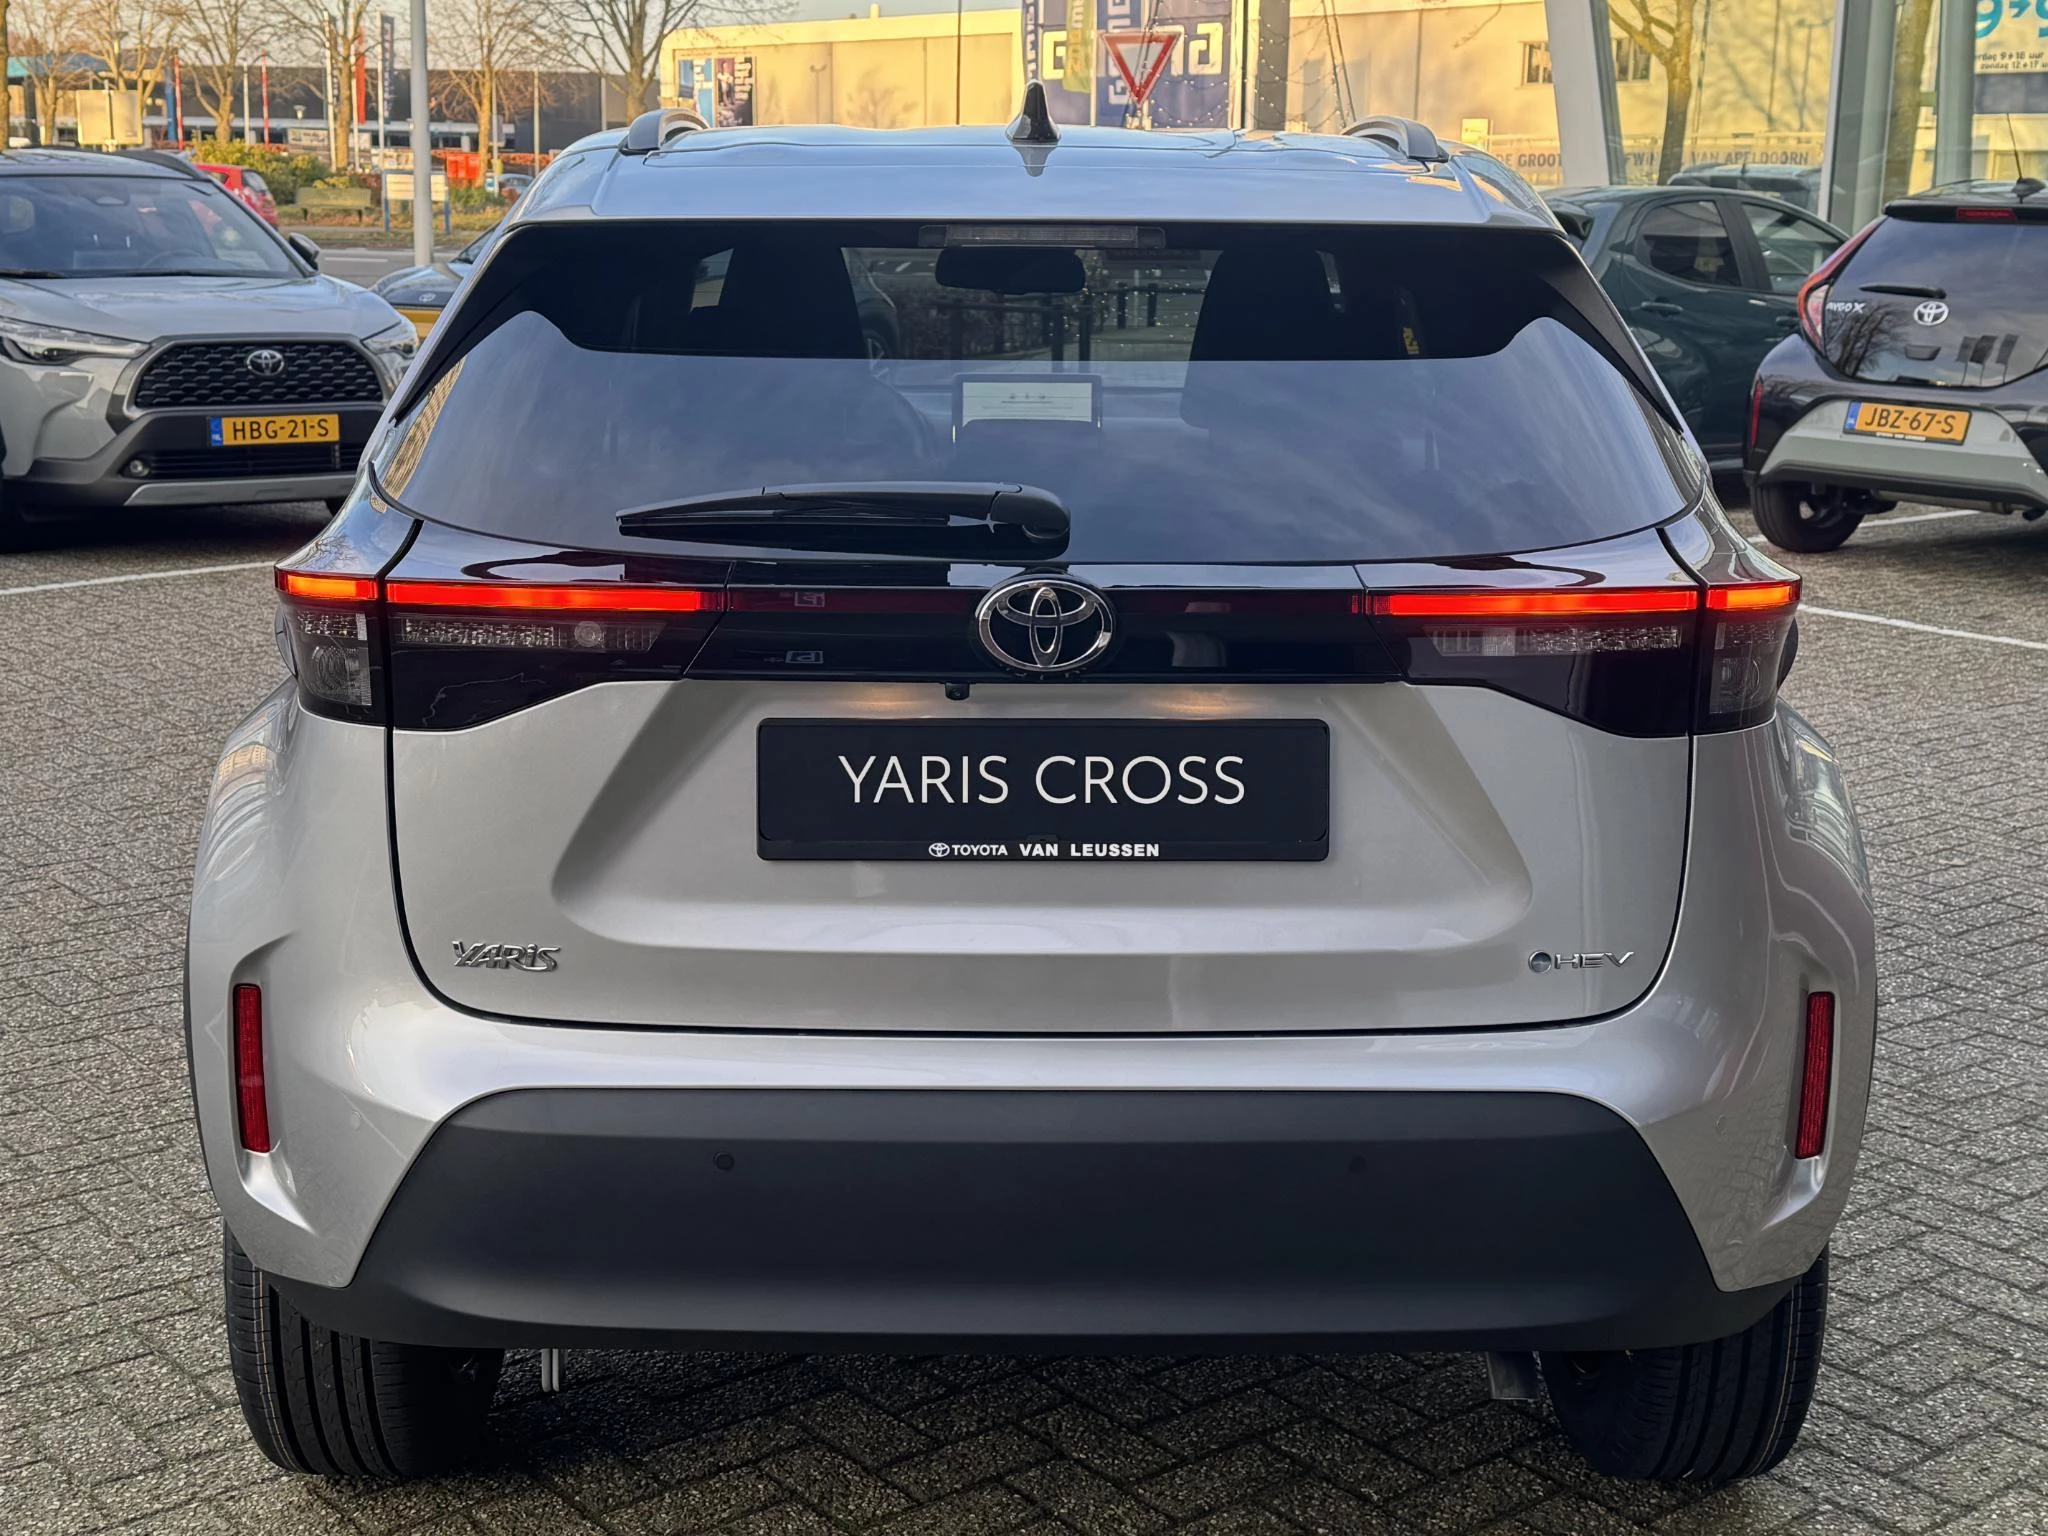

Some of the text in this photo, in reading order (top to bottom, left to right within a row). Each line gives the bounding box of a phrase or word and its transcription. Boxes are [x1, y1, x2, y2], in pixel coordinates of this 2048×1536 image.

[232, 418, 329, 441] HBG-21-S
[1864, 406, 1957, 434] JBZ-67-S
[838, 755, 1246, 805] YARIS CROSS
[951, 843, 1160, 857] TOYOTA VAN LEUSSEN
